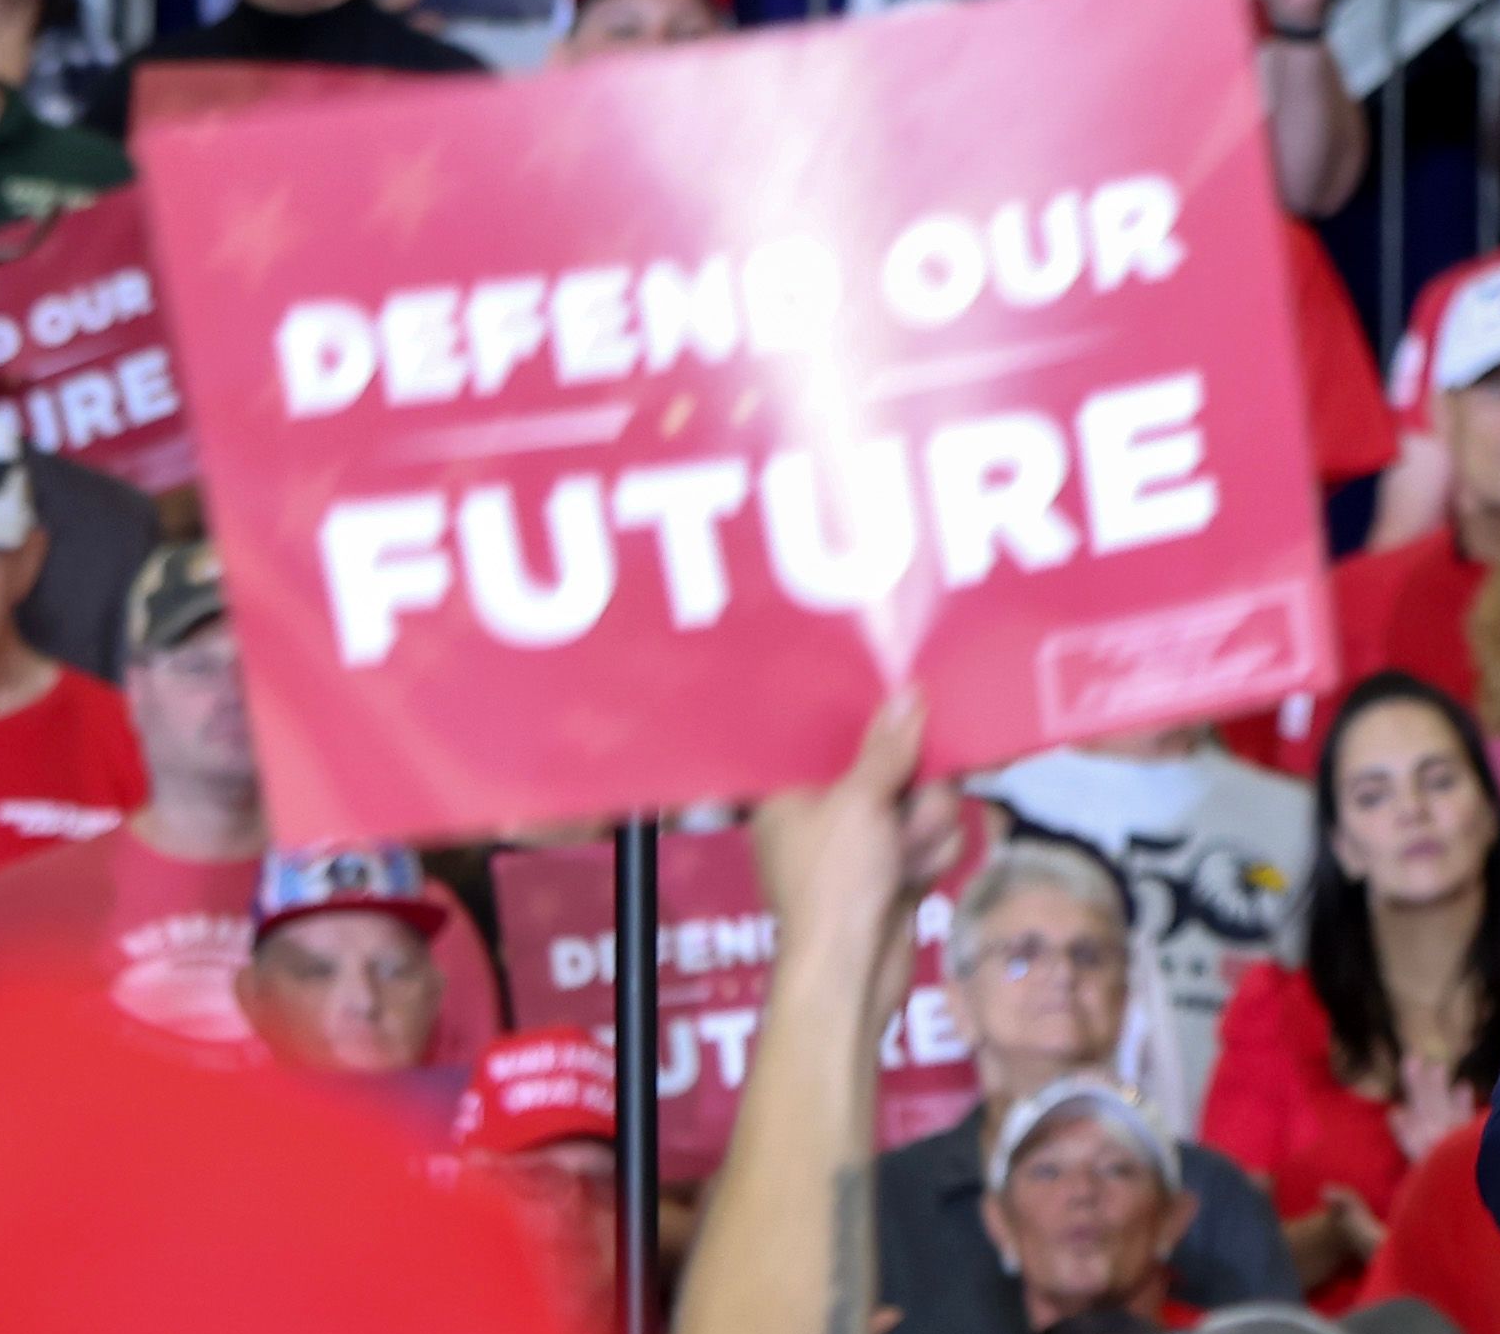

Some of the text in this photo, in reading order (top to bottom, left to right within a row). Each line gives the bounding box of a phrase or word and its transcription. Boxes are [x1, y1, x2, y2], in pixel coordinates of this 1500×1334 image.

[274, 174, 1186, 419] DEFEND OUR
[316, 370, 1222, 669] FUTURE
